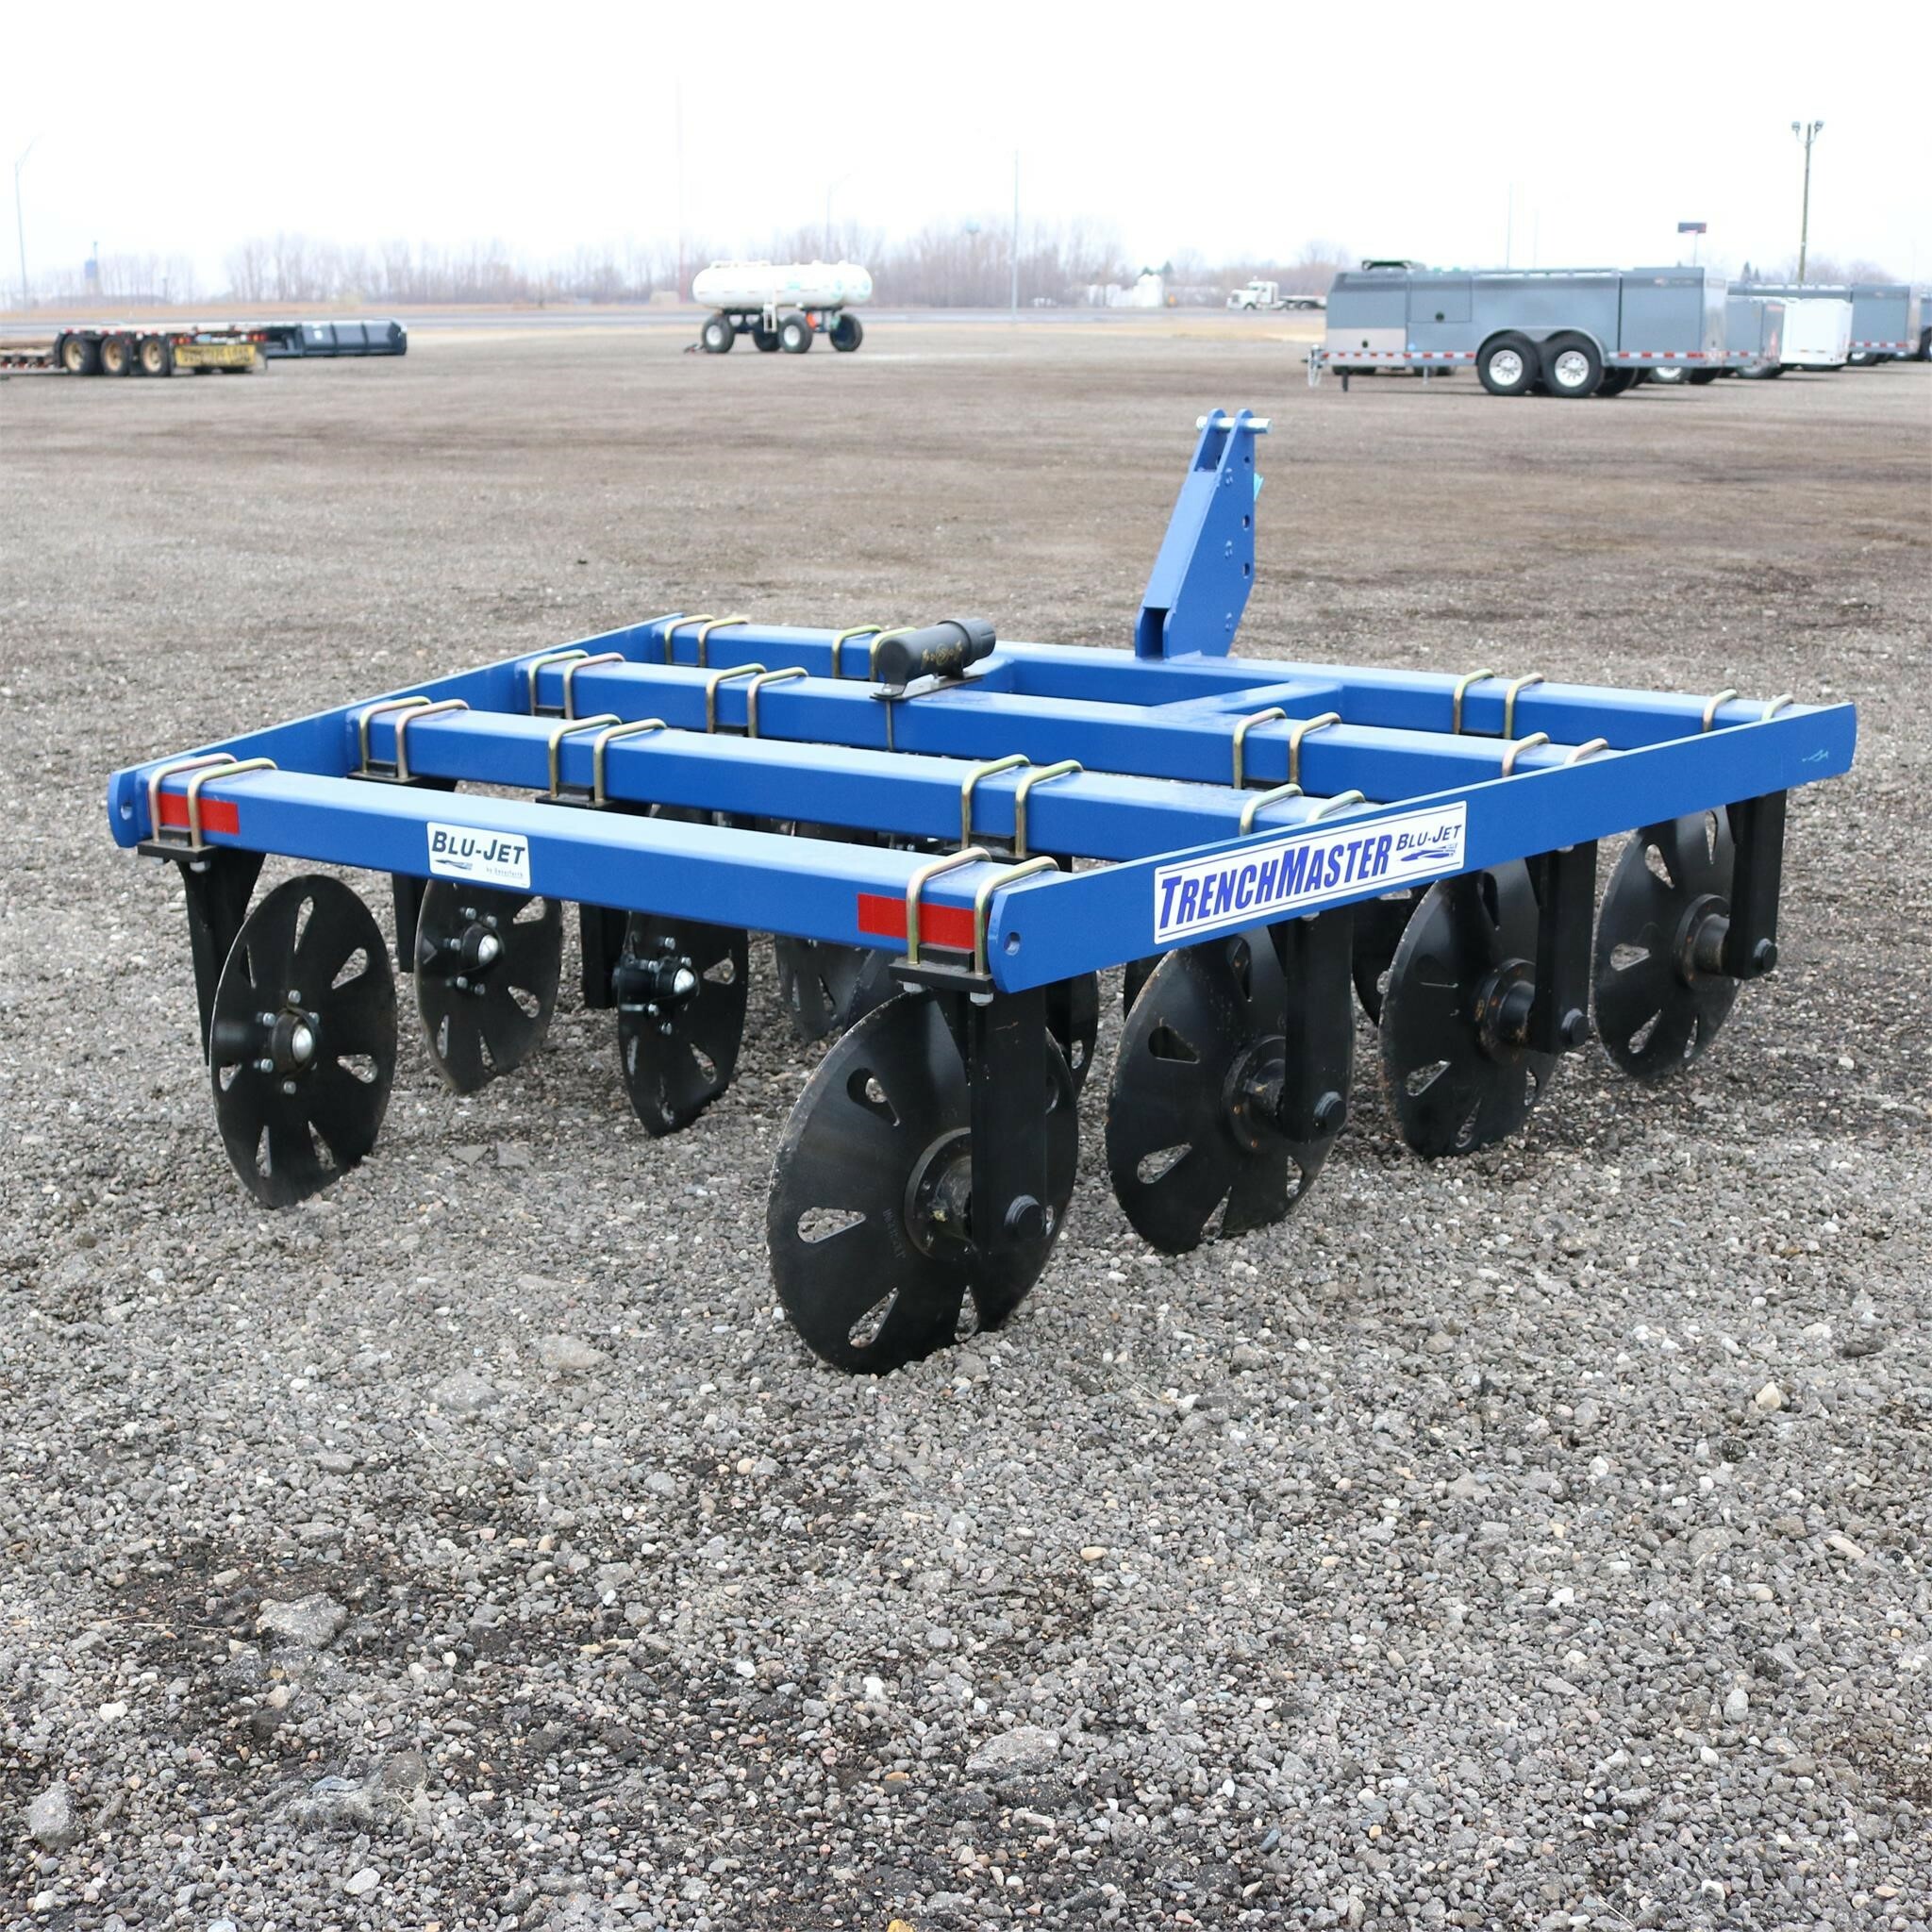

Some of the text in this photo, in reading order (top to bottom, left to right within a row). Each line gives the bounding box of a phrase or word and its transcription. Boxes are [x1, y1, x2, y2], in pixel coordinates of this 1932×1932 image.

[432, 830, 525, 864] BLU-JET
[1396, 824, 1462, 851] BLU-JET
[1159, 834, 1392, 929] TRENCHMASTER
